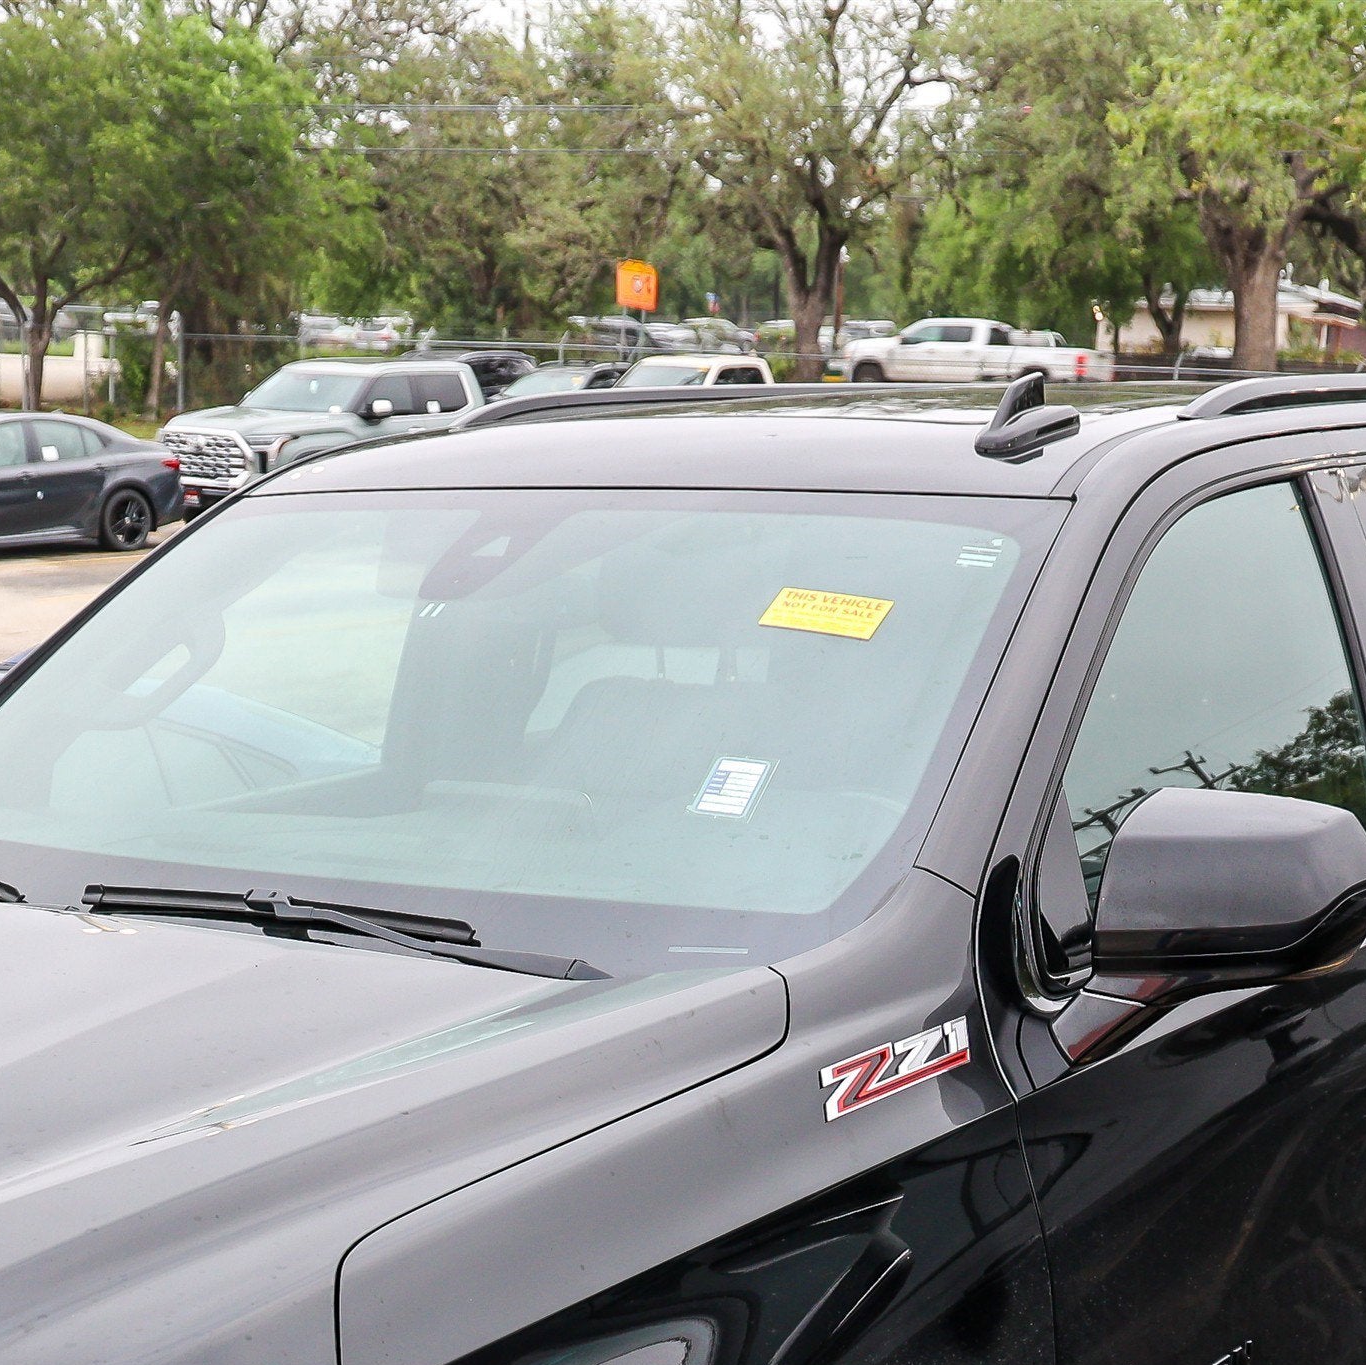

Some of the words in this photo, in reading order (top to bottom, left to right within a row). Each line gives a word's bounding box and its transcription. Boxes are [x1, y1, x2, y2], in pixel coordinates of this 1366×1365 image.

[783, 601, 806, 609] NOT
[811, 604, 838, 614] FOR
[842, 609, 874, 619] SALE
[785, 591, 818, 601] THIS
[823, 595, 885, 611] VEHICLE
[819, 1015, 971, 1122] Z71
